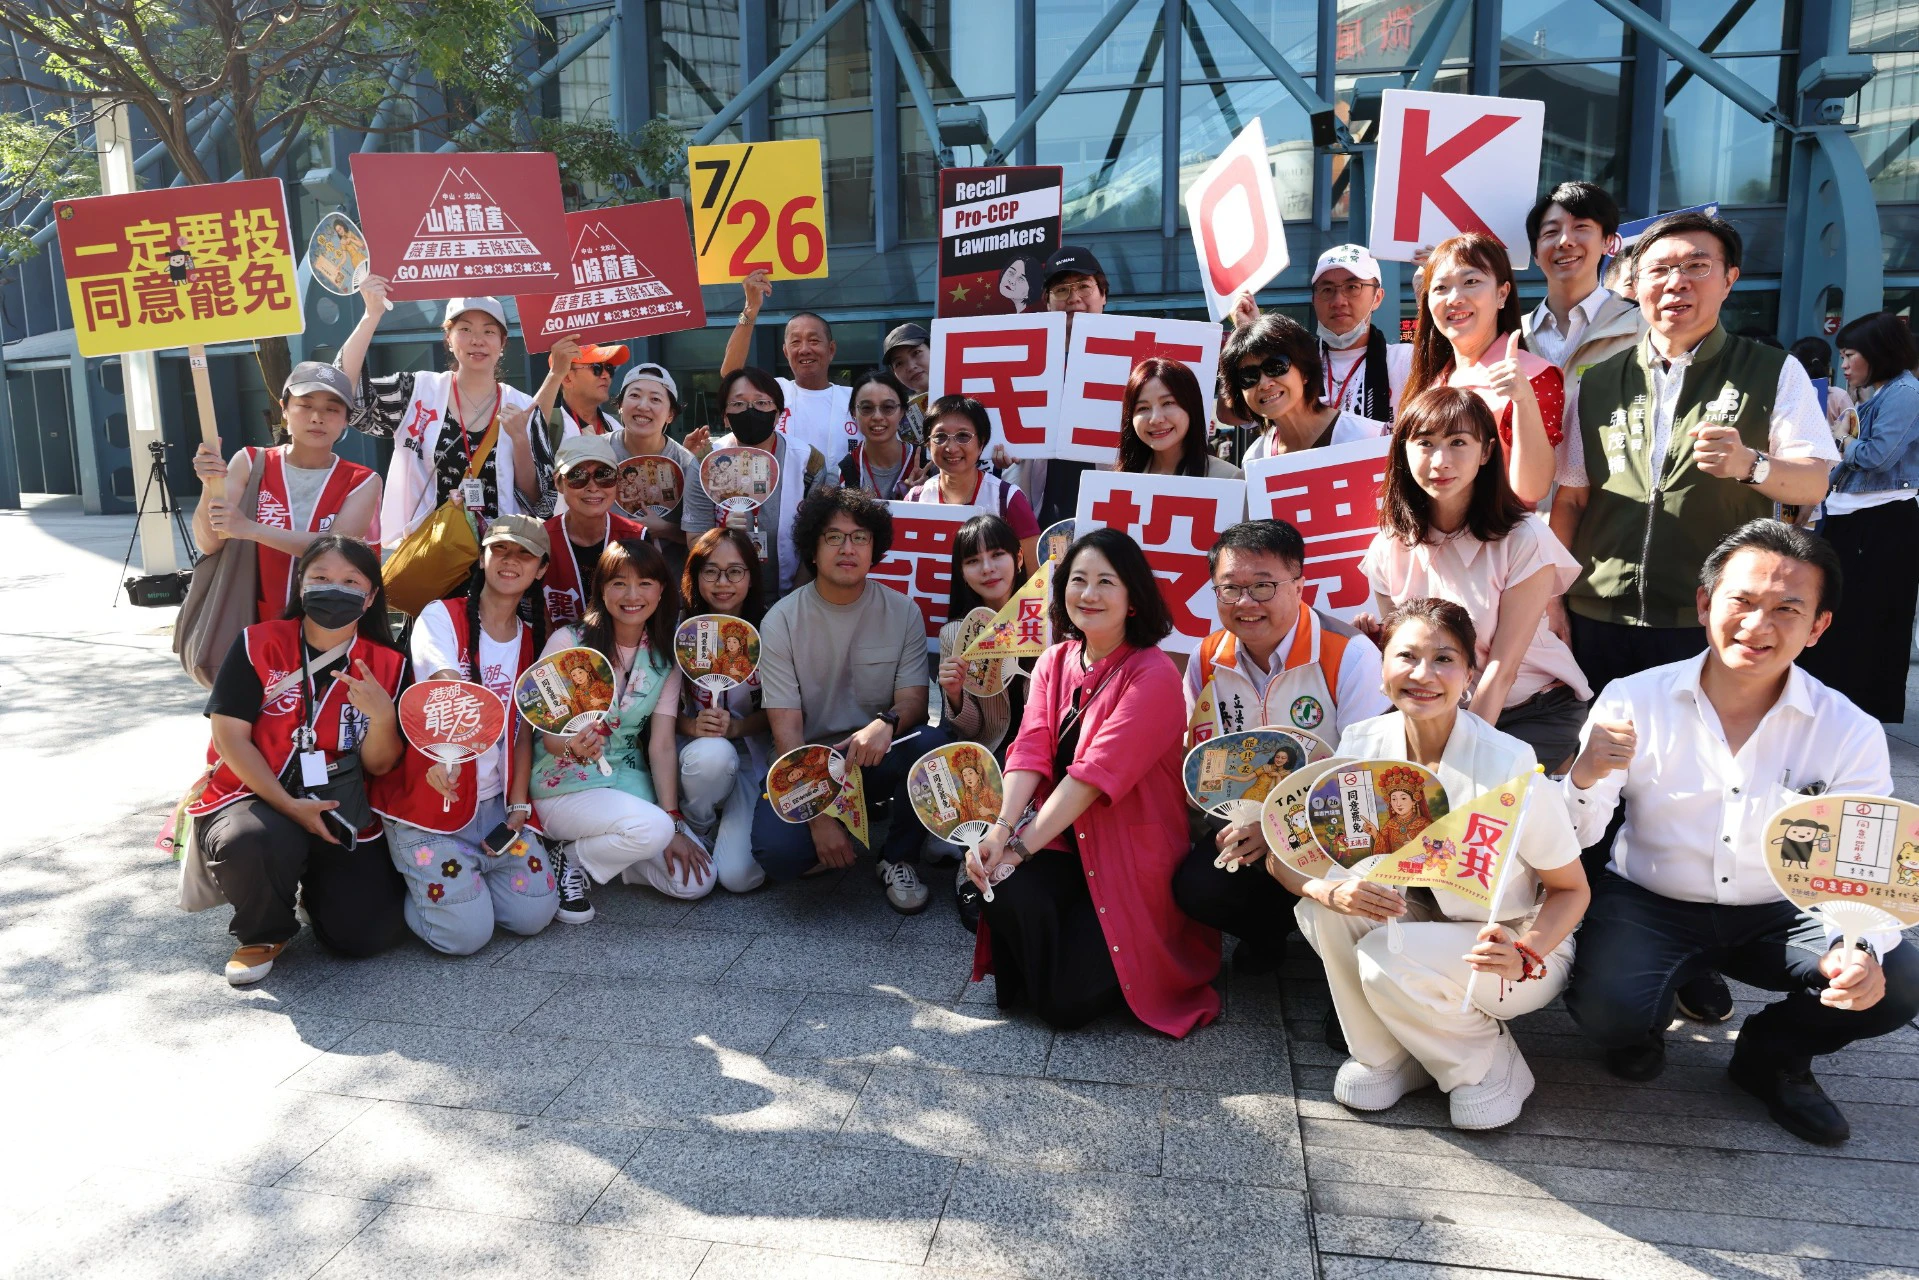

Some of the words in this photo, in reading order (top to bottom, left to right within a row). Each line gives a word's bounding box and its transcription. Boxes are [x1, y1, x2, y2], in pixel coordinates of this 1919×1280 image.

[955, 174, 1007, 202] Recall
[1393, 108, 1521, 250] K
[426, 204, 504, 233] 山除薇害
[695, 145, 824, 277] 7/26
[955, 200, 1019, 229] Pro-CCP
[1200, 154, 1269, 297] O
[75, 207, 285, 273] 一定要投
[954, 225, 1046, 258] Lawmakers
[398, 264, 419, 279] GO
[421, 263, 459, 279] AWAY
[80, 263, 292, 332] 同意罷免
[545, 316, 564, 332] GO
[566, 312, 600, 329] AWAY
[943, 326, 1048, 445] 民
[1705, 413, 1738, 422] TAIPEI
[1091, 488, 1218, 638] 投
[1016, 597, 1044, 646] 反共
[428, 683, 461, 702] 港湖
[422, 695, 485, 743] 罷秀
[1347, 789, 1364, 834] 同意罷免
[1457, 812, 1509, 890] 反共
[1853, 819, 1870, 862] 同意罷免
